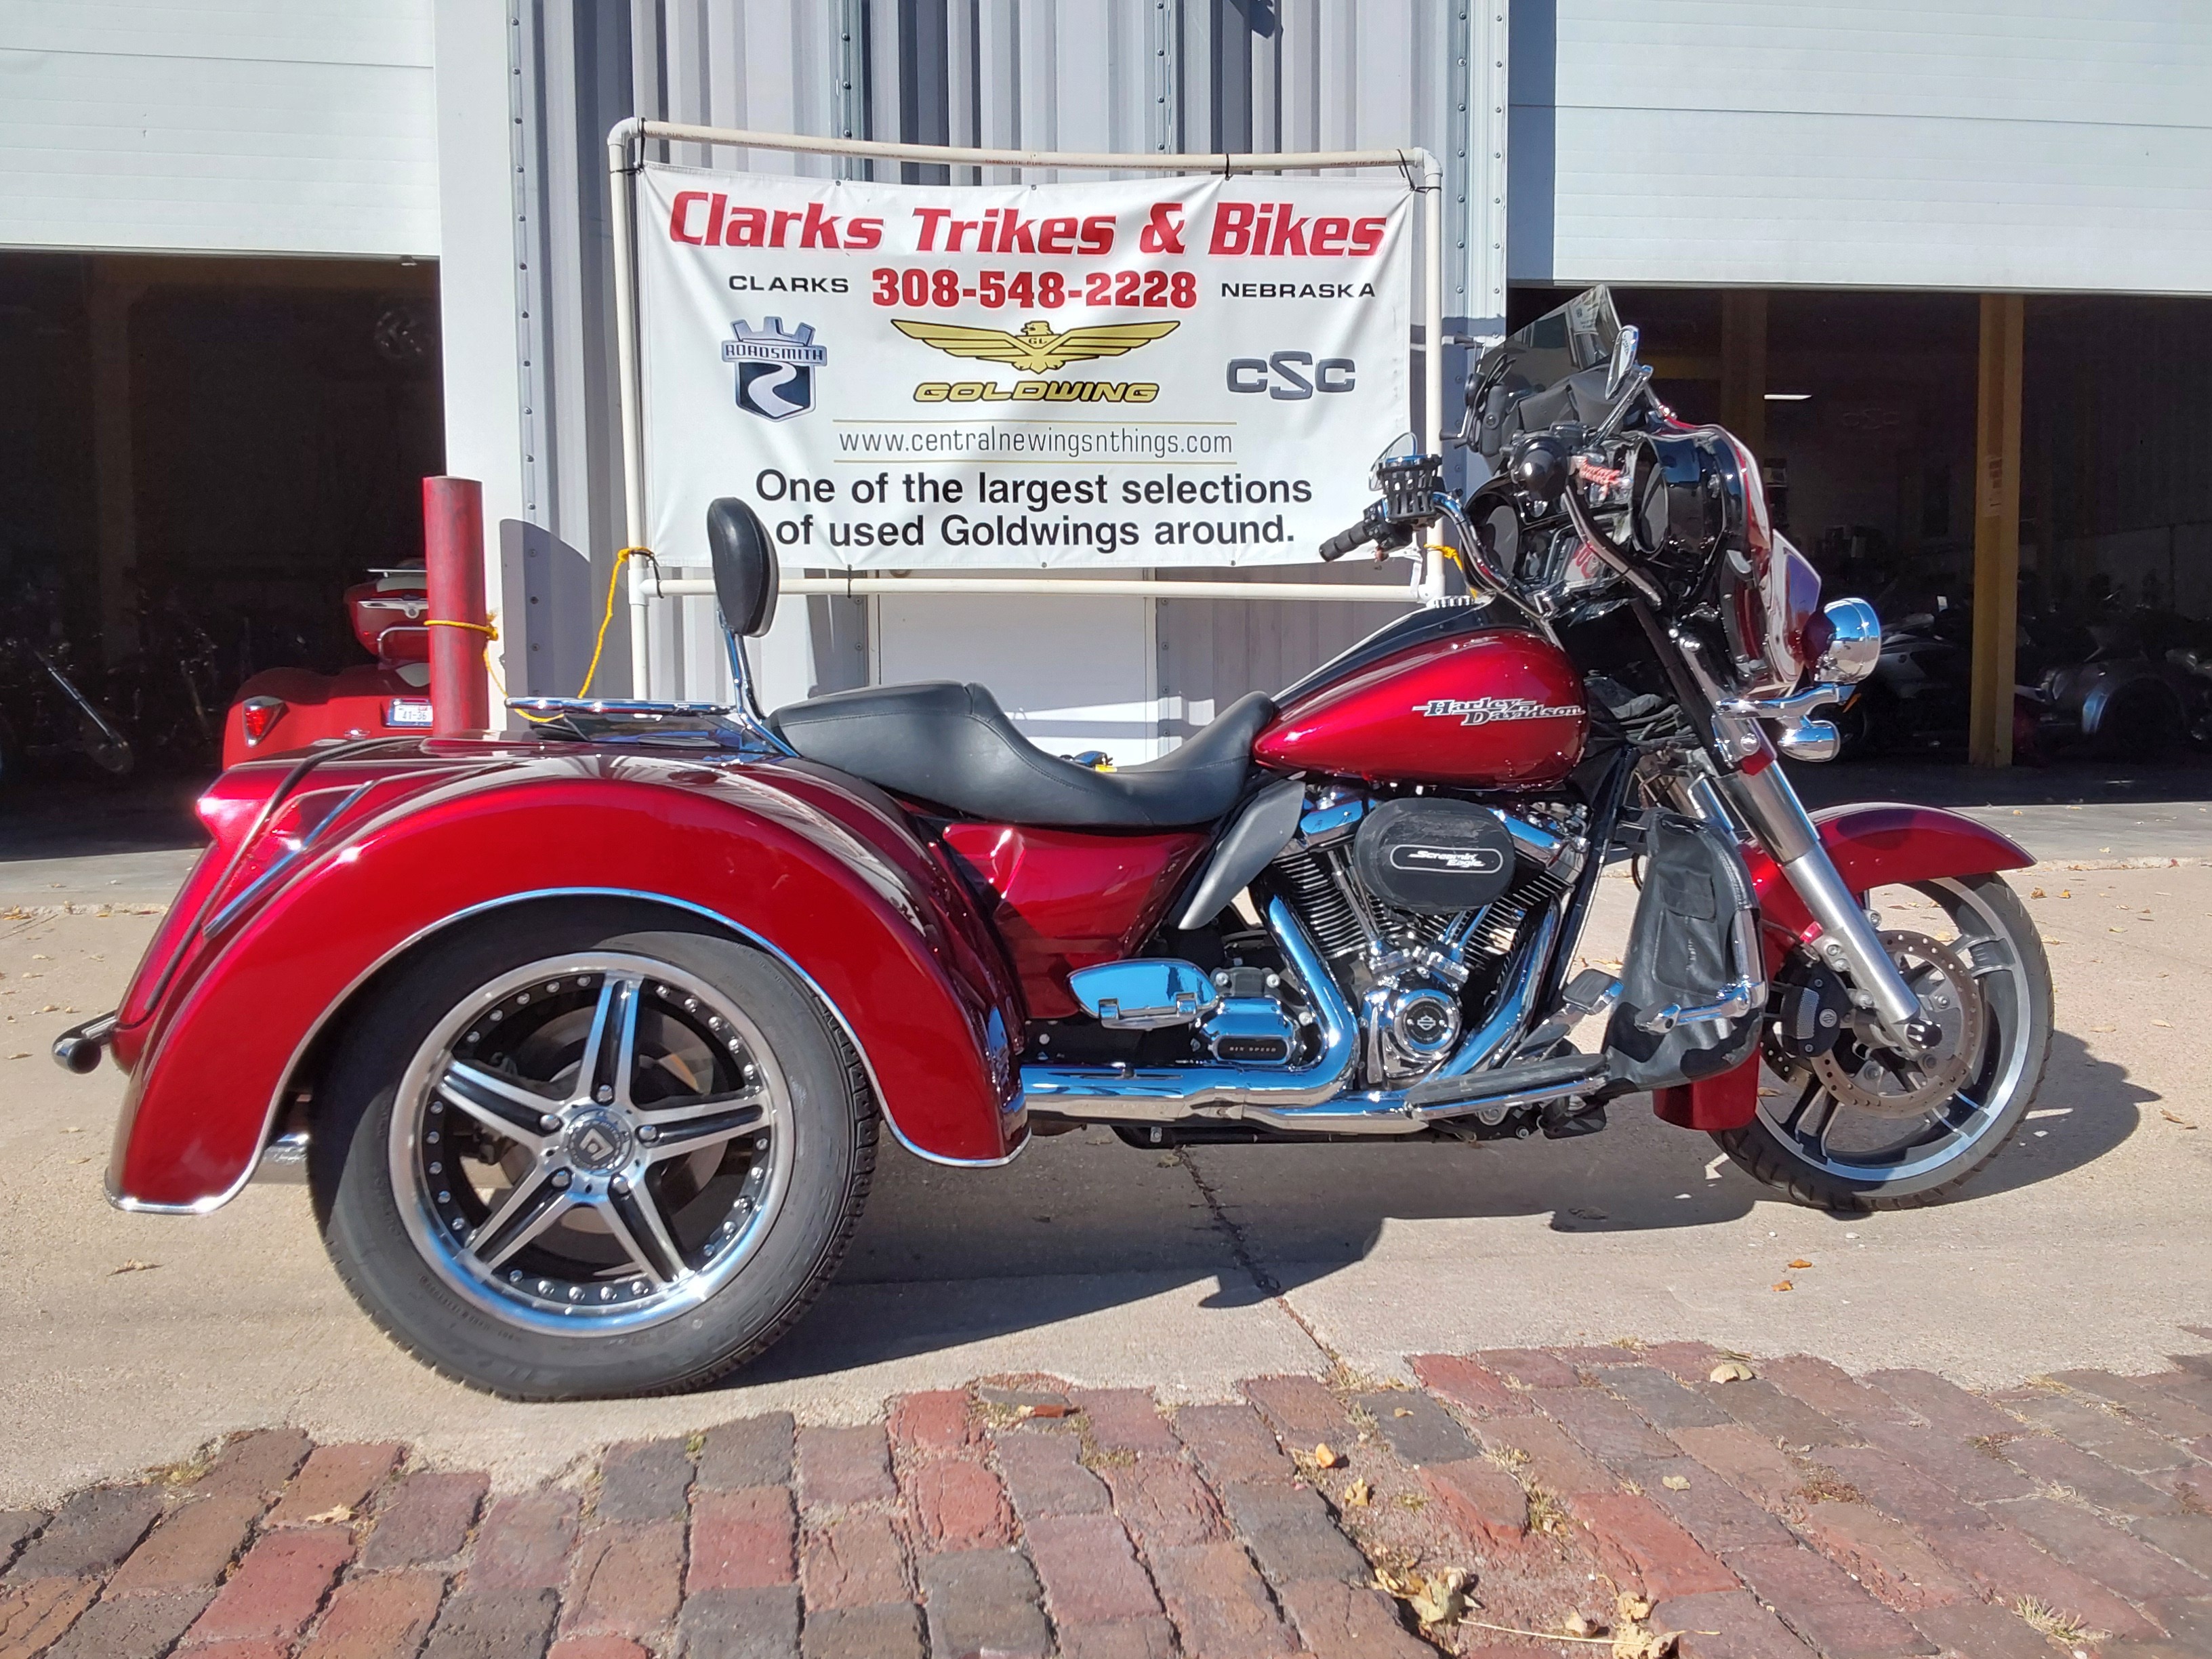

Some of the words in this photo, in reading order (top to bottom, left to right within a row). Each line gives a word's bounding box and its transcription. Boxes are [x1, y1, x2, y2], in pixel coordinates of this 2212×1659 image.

[669, 190, 884, 249] Clarks
[912, 206, 1116, 255] Trikes
[1140, 203, 1186, 255] &
[1208, 203, 1387, 256] Bikes
[729, 275, 848, 293] CLARKS
[872, 268, 1197, 309] 308-548-2228
[1221, 283, 1375, 298] NEBRASKA
[726, 344, 823, 361] ROADSMITH
[914, 381, 1160, 403] GOLDWING
[840, 426, 1233, 457] www.centralnewingsnthings.com
[756, 469, 836, 504] One
[852, 471, 888, 504] of
[903, 472, 963, 504] the
[979, 472, 1108, 512] largest
[1122, 473, 1313, 504] selections
[776, 514, 815, 545] of
[830, 515, 924, 546] used
[941, 515, 1140, 554] Goldwings
[1154, 514, 1295, 545] around.
[1412, 697, 1537, 717] Harley
[1460, 705, 1586, 726] Davidson
[1446, 859, 1486, 867] Eagle
